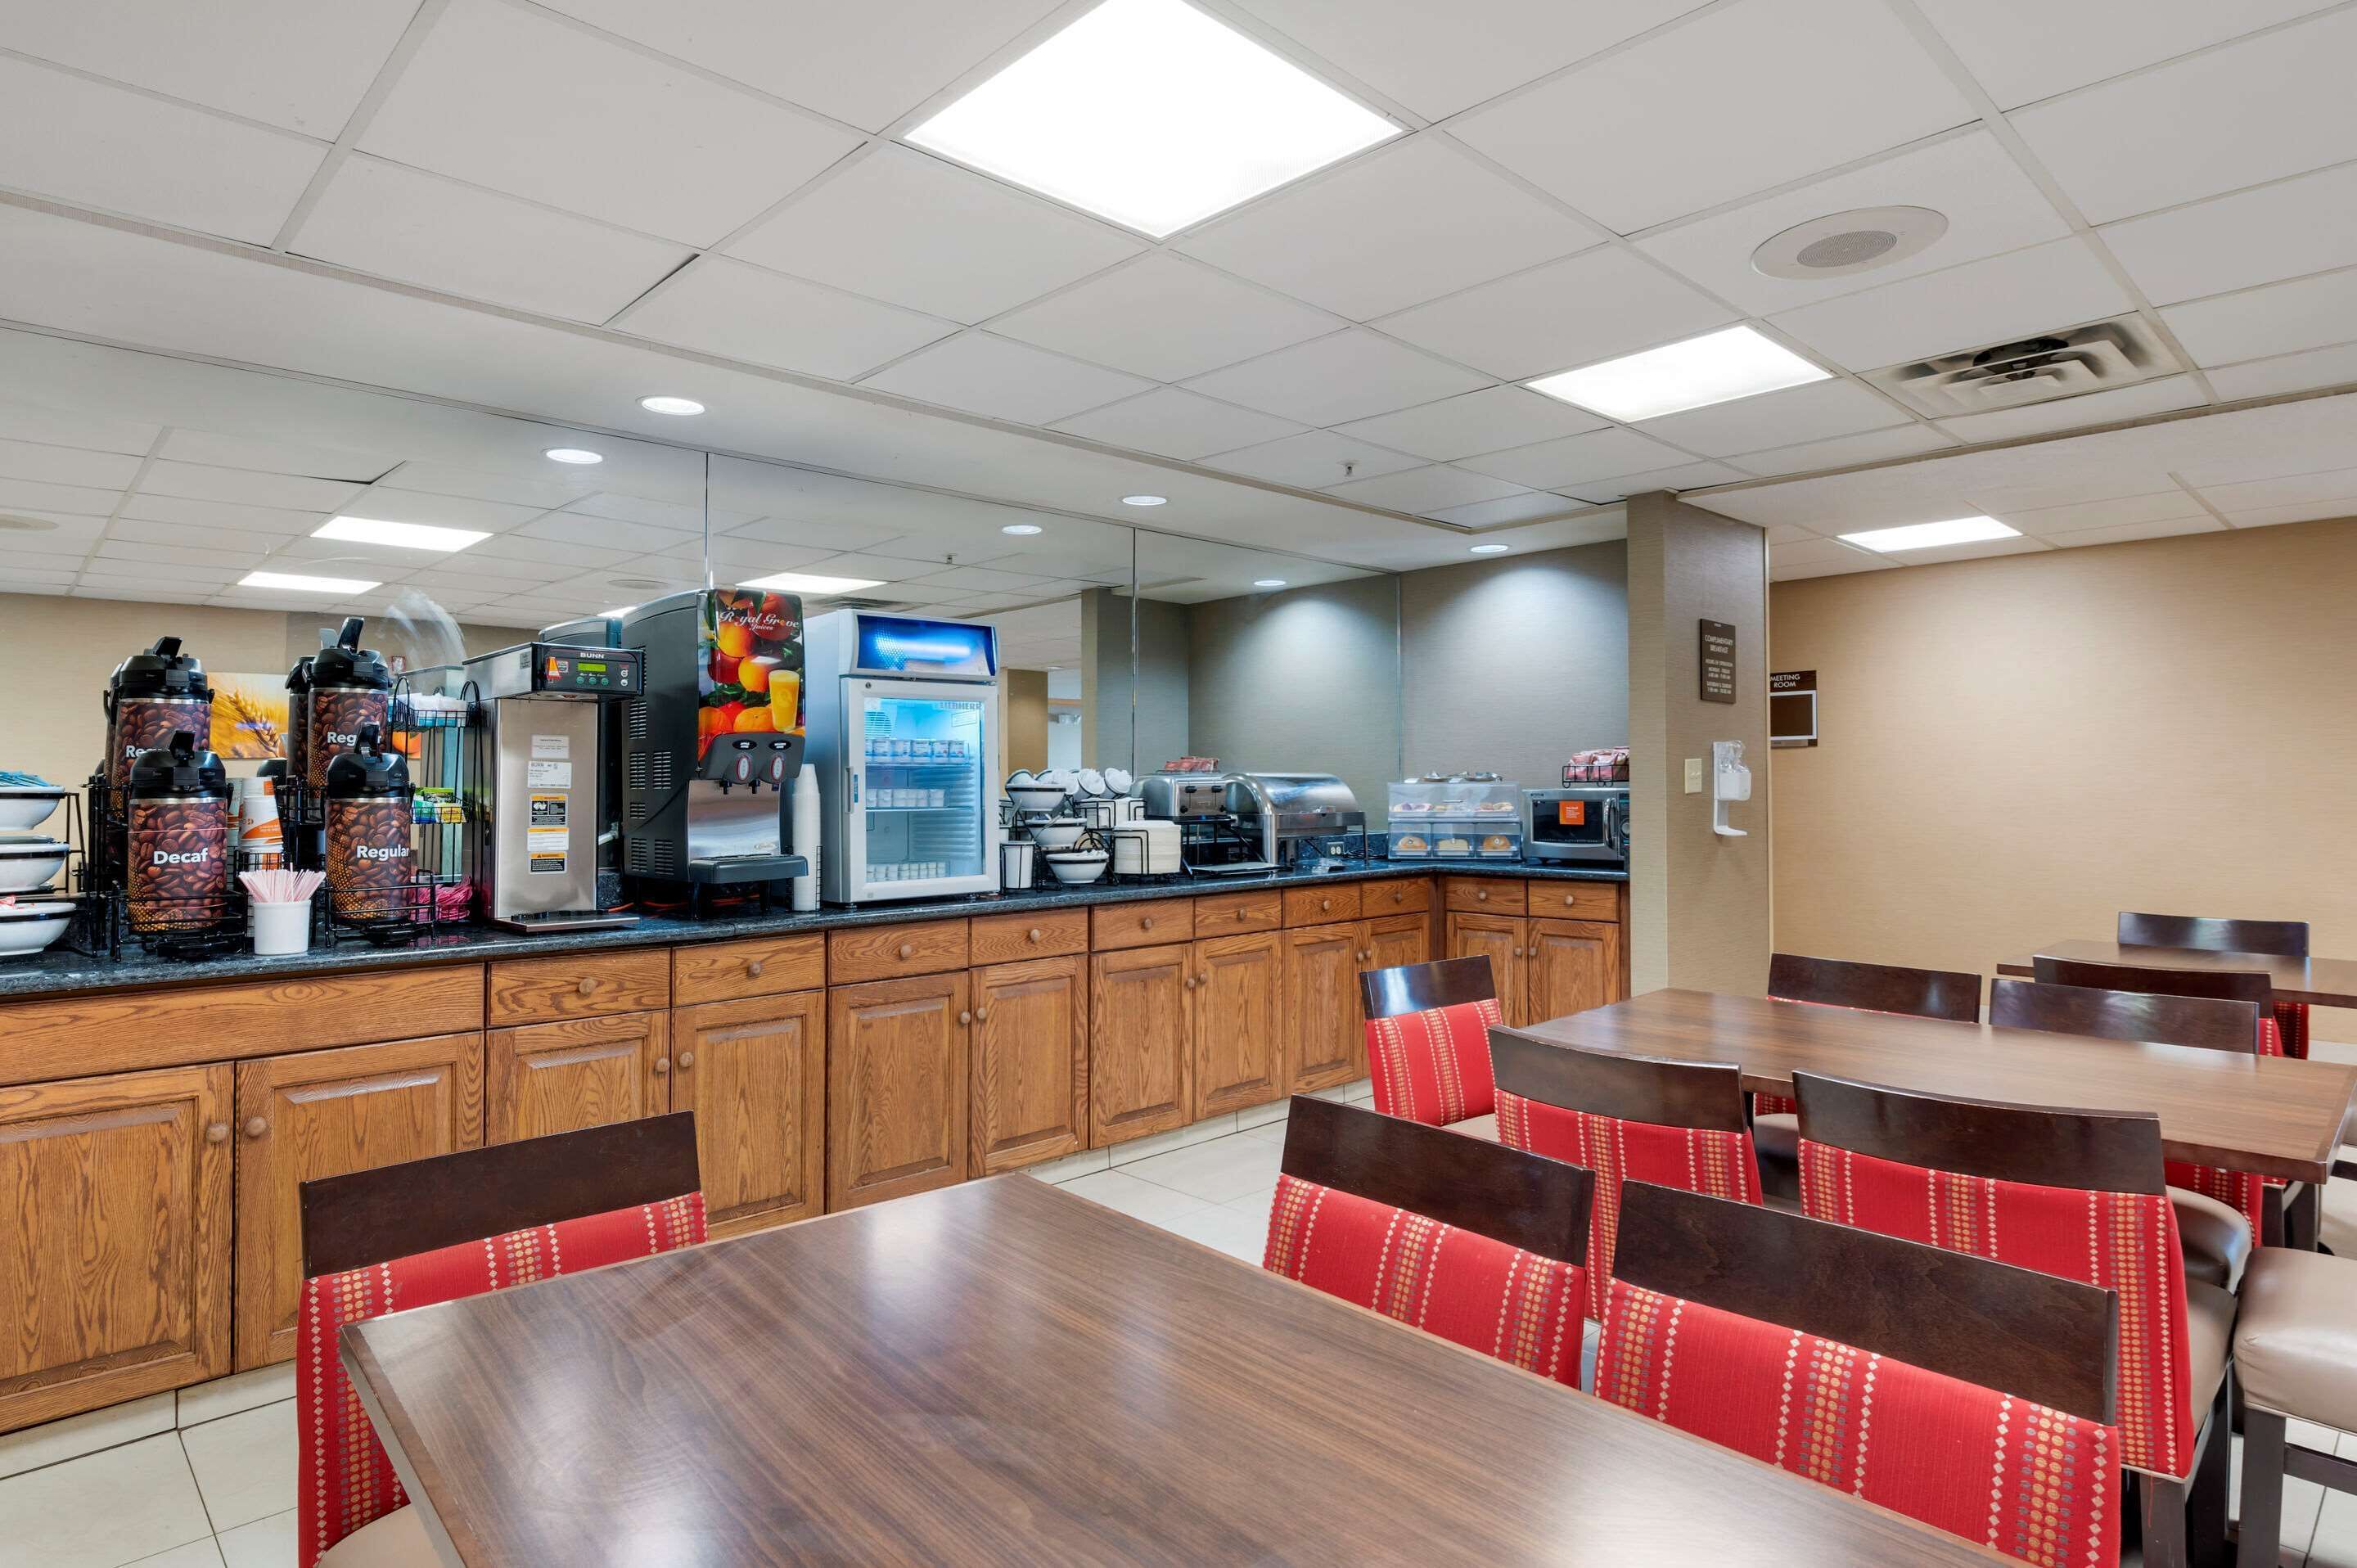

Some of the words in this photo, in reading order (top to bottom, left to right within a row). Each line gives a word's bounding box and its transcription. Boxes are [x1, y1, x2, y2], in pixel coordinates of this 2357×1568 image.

[327, 732, 381, 746] Regr
[153, 848, 209, 865] Decaf
[357, 845, 409, 861] Regular
